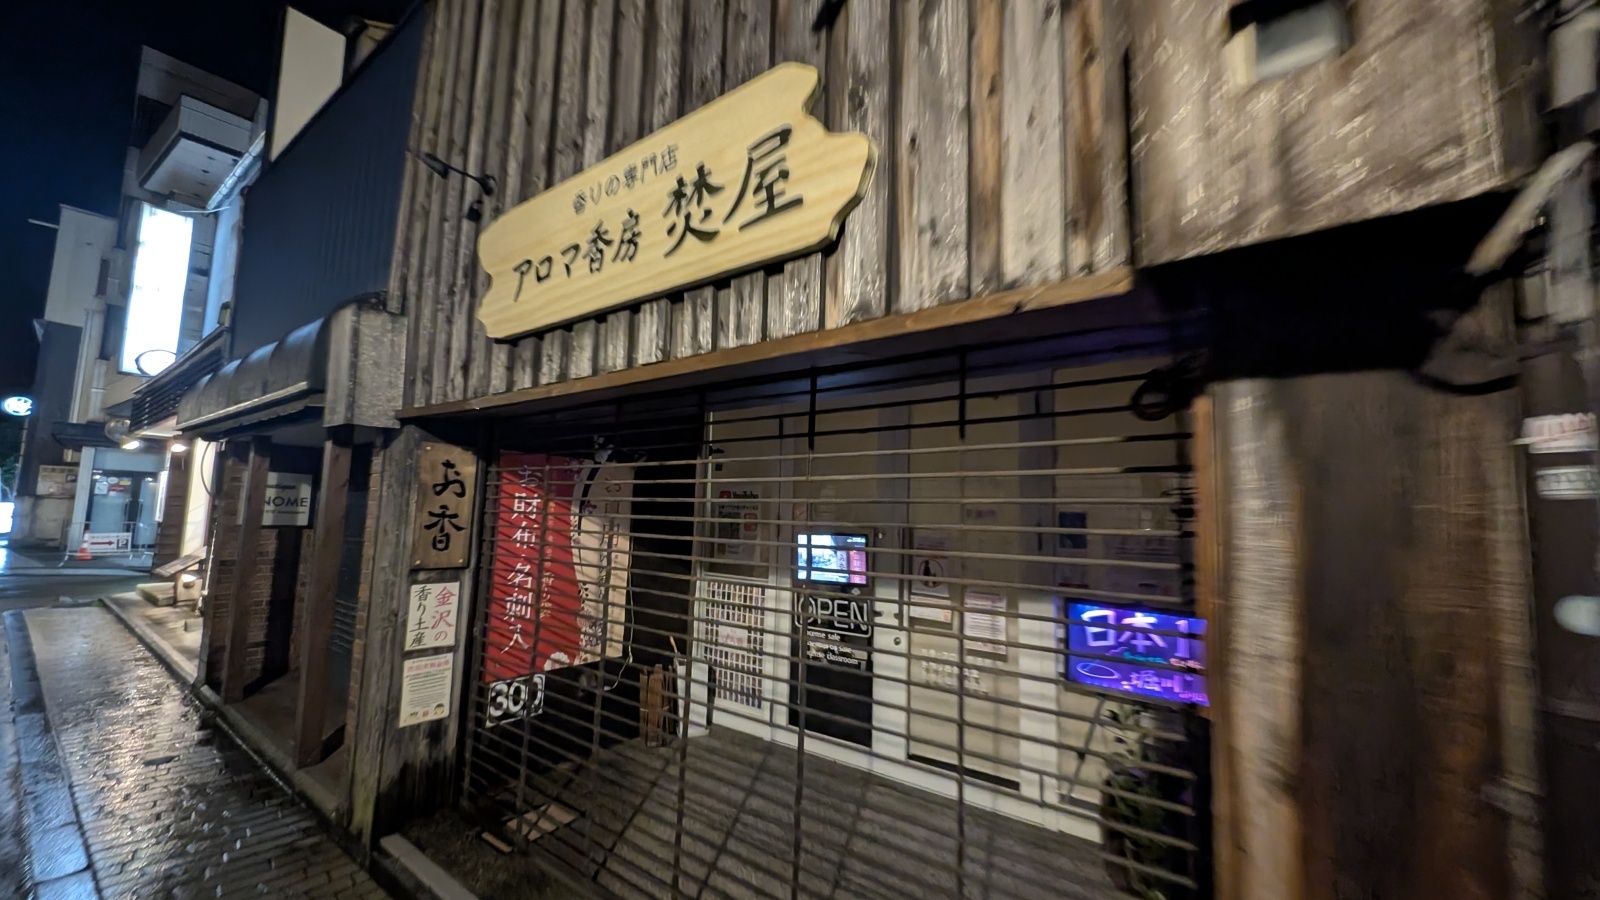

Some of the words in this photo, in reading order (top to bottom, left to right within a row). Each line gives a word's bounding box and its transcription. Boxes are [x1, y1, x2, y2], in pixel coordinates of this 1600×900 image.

[513, 208, 642, 302] アロマ香房
[661, 123, 803, 258] 焚屋
[424, 459, 466, 551] お香
[409, 585, 432, 648] 香り土産
[431, 586, 456, 641] 金沢の
[798, 596, 868, 631] OPEN
